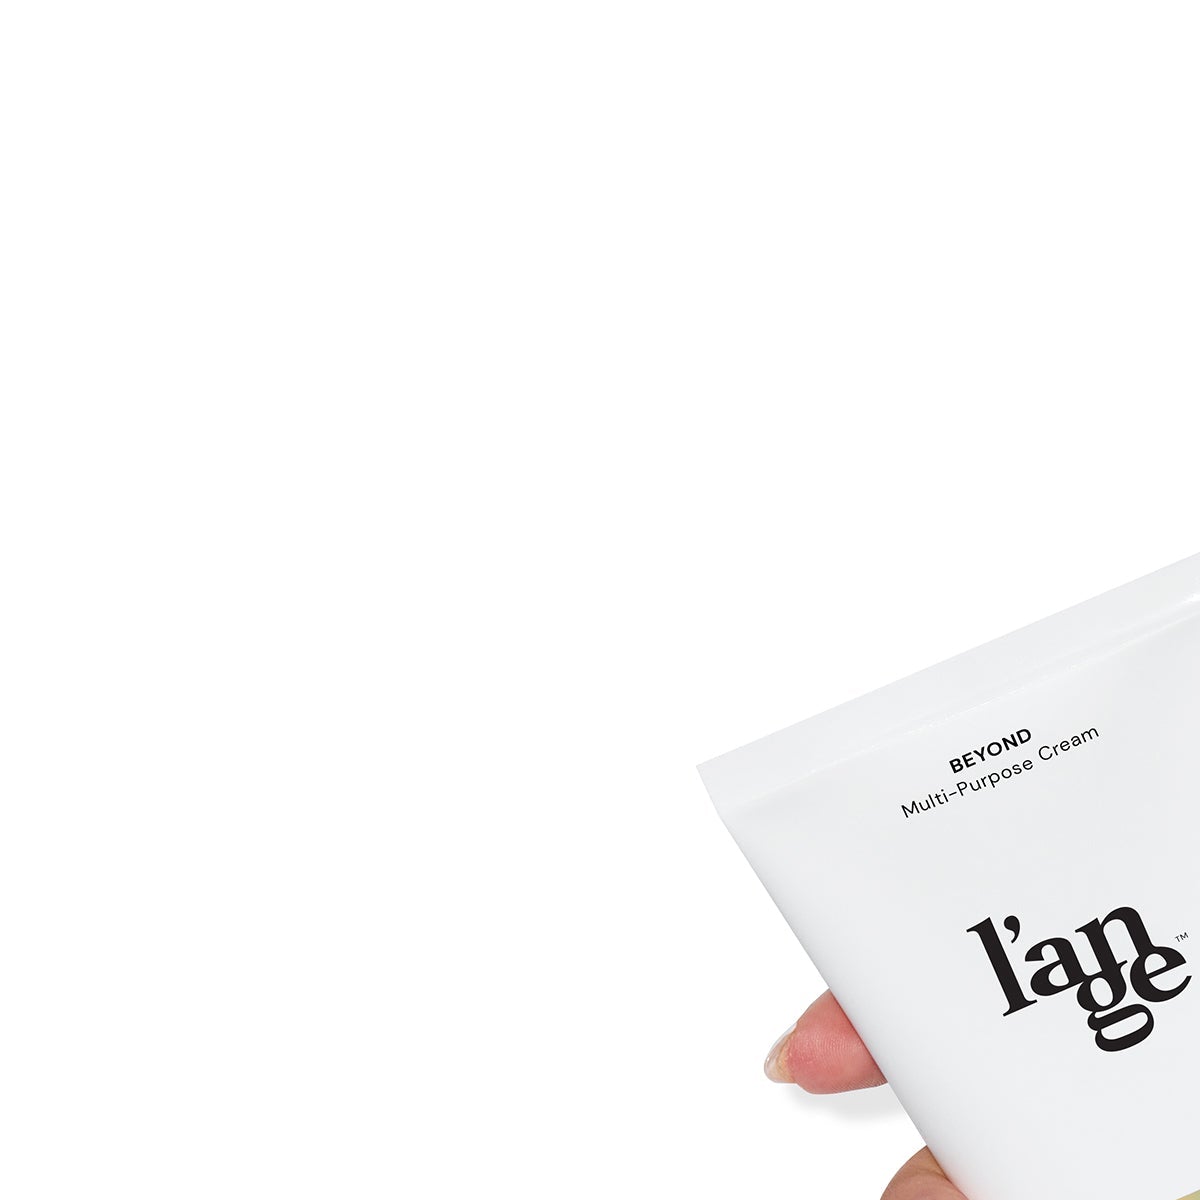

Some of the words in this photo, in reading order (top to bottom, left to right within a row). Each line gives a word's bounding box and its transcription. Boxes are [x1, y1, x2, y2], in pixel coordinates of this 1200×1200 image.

[901, 759, 1034, 819] Multi-Purpose
[1038, 727, 1100, 761] Cream
[949, 728, 1032, 774] BEYOND
